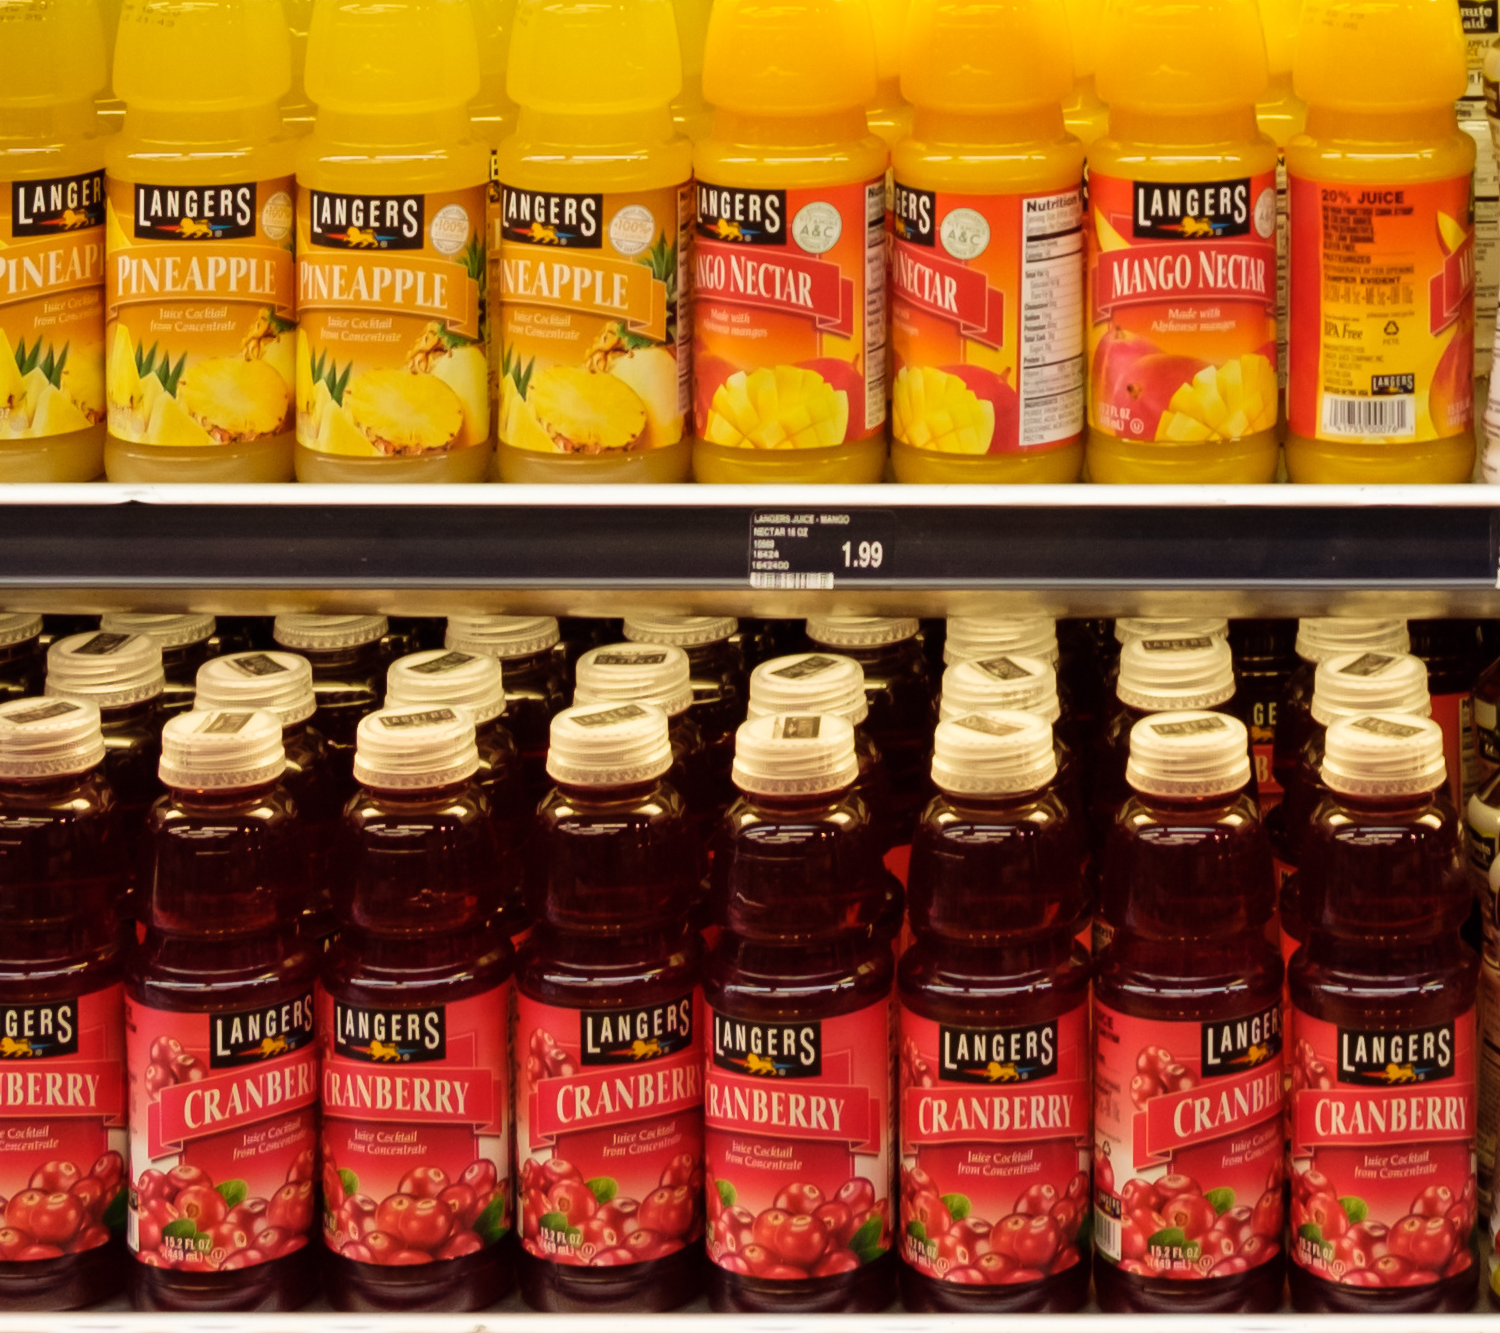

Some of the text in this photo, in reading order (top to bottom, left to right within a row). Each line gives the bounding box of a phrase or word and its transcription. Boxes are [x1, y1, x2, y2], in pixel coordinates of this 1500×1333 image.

[139, 188, 252, 229] LANGERS
[1138, 185, 1247, 228] LANGERS
[1320, 189, 1405, 207] 20% JUICE
[117, 252, 277, 298] PINEAPPLE
[1112, 248, 1266, 297] MANGO NECTAR
[842, 540, 883, 568] 1.99
[944, 1027, 1053, 1068] LANGERS
[918, 1093, 1073, 1135] CRANBERRY
